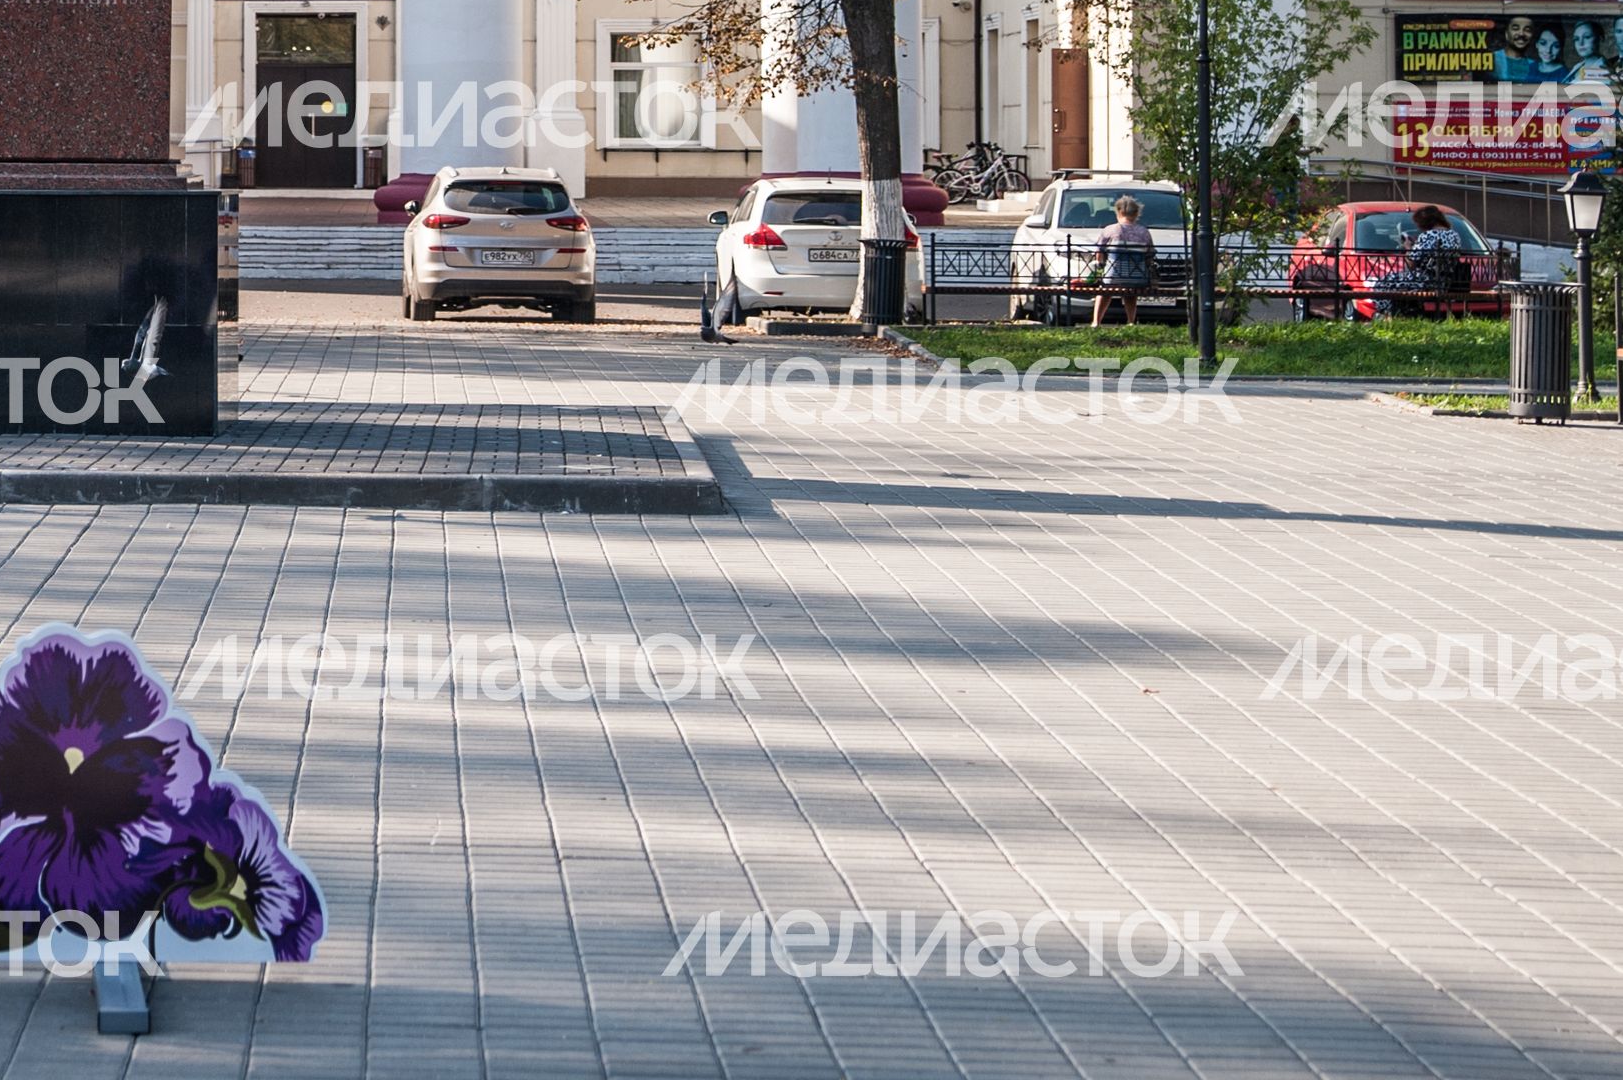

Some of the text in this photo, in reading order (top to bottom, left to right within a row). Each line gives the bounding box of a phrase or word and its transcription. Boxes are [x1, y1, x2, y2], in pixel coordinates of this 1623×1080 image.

[1403, 32, 1488, 50] В РАМКАХ
[1403, 53, 1494, 71] ПРИЛИЧИЯ
[1397, 122, 1429, 158] 13
[1432, 125, 1514, 138] ОКТЯБРЯ
[1520, 123, 1561, 139] 12-00
[1432, 151, 1471, 159] ИНФО:
